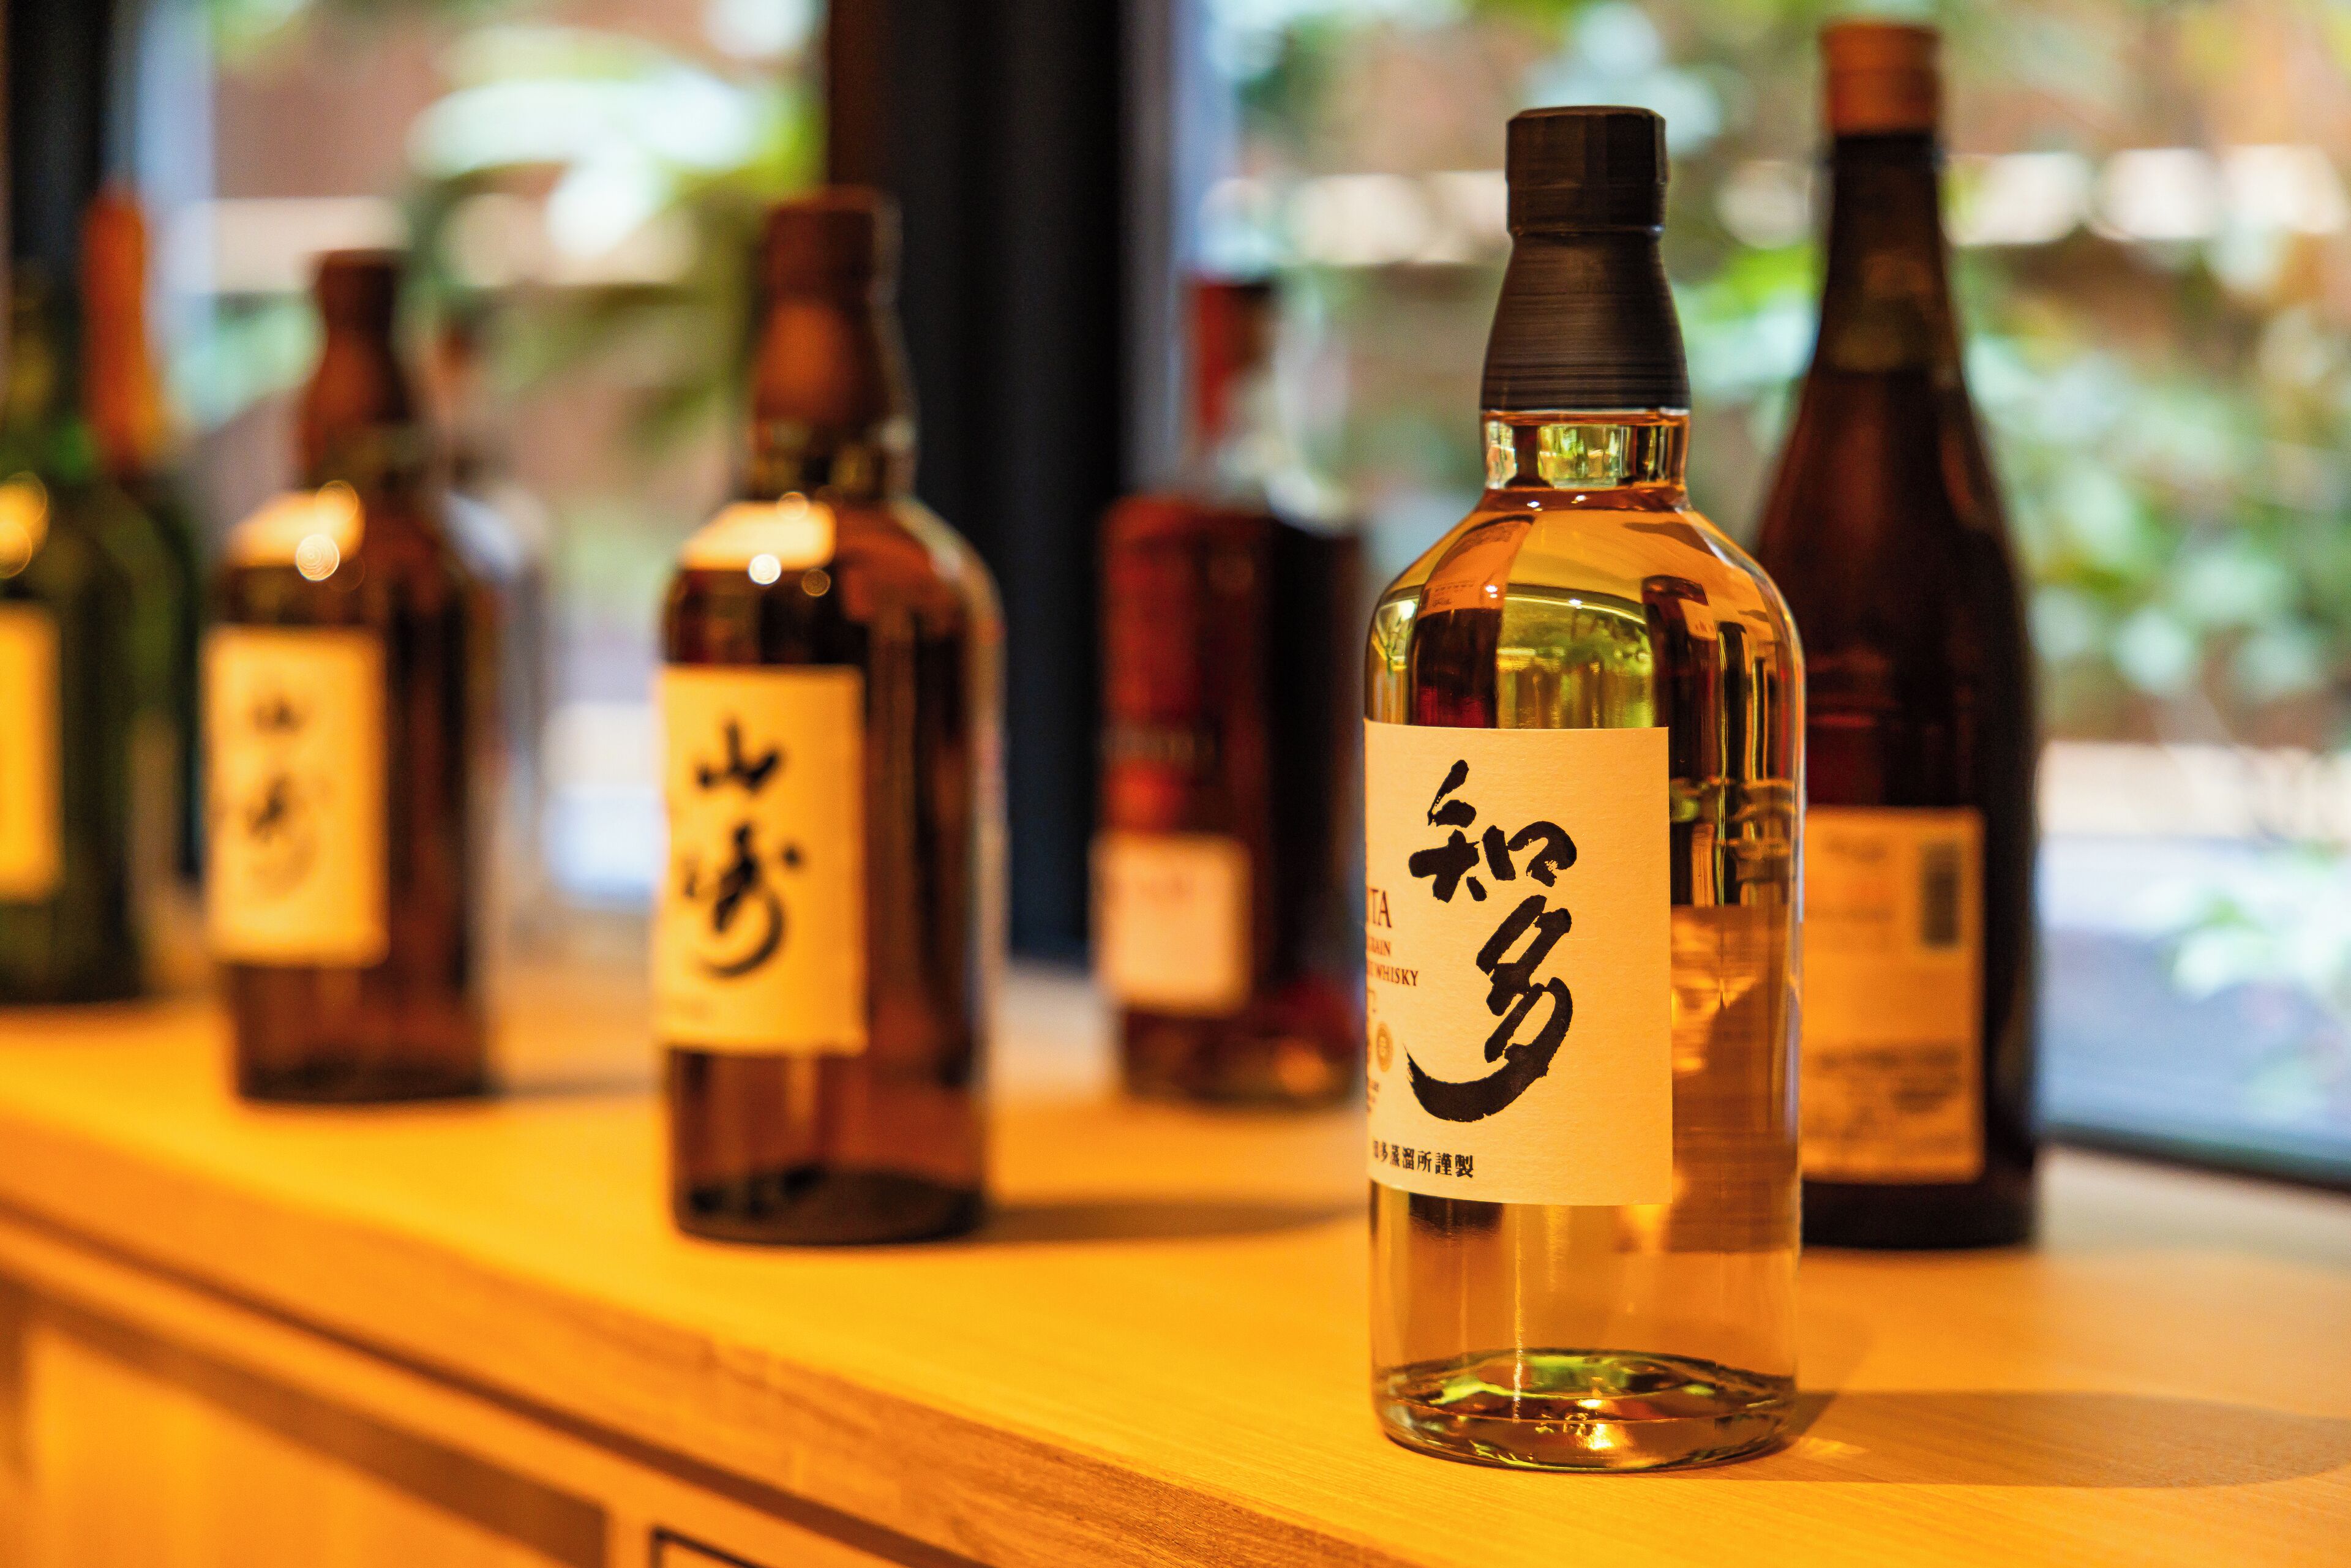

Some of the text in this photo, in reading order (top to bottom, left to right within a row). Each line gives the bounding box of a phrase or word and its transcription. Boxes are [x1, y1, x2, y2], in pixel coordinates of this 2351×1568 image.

[1370, 889, 1392, 928] TA
[1404, 759, 1577, 1122] 知多
[1376, 963, 1419, 986] WHISKY
